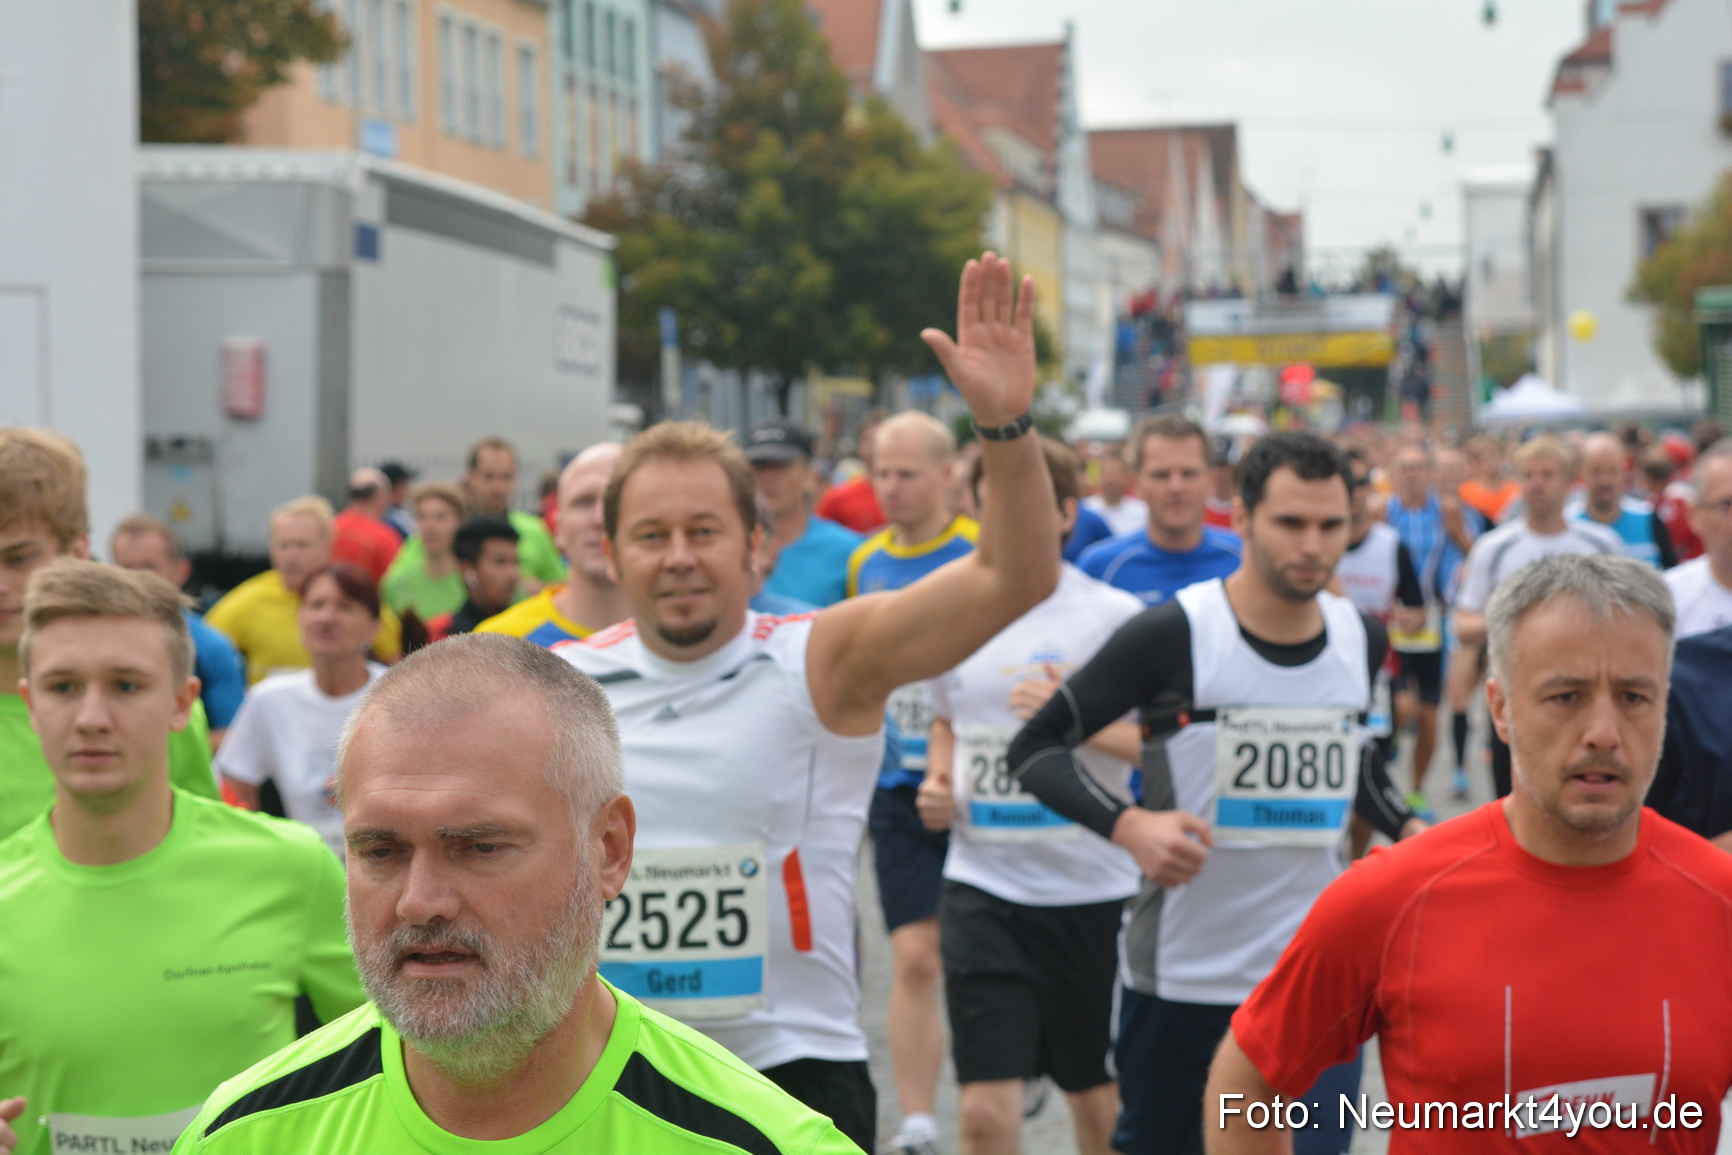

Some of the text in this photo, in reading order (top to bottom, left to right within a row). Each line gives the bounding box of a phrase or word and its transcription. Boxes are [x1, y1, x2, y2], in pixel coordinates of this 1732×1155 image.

[971, 754, 1020, 796] 28
[1233, 742, 1344, 789] 2080
[645, 862, 732, 880] Neumarkt
[604, 888, 749, 951] 2525
[647, 967, 703, 994] Gerd
[55, 1131, 124, 1155] PARTL
